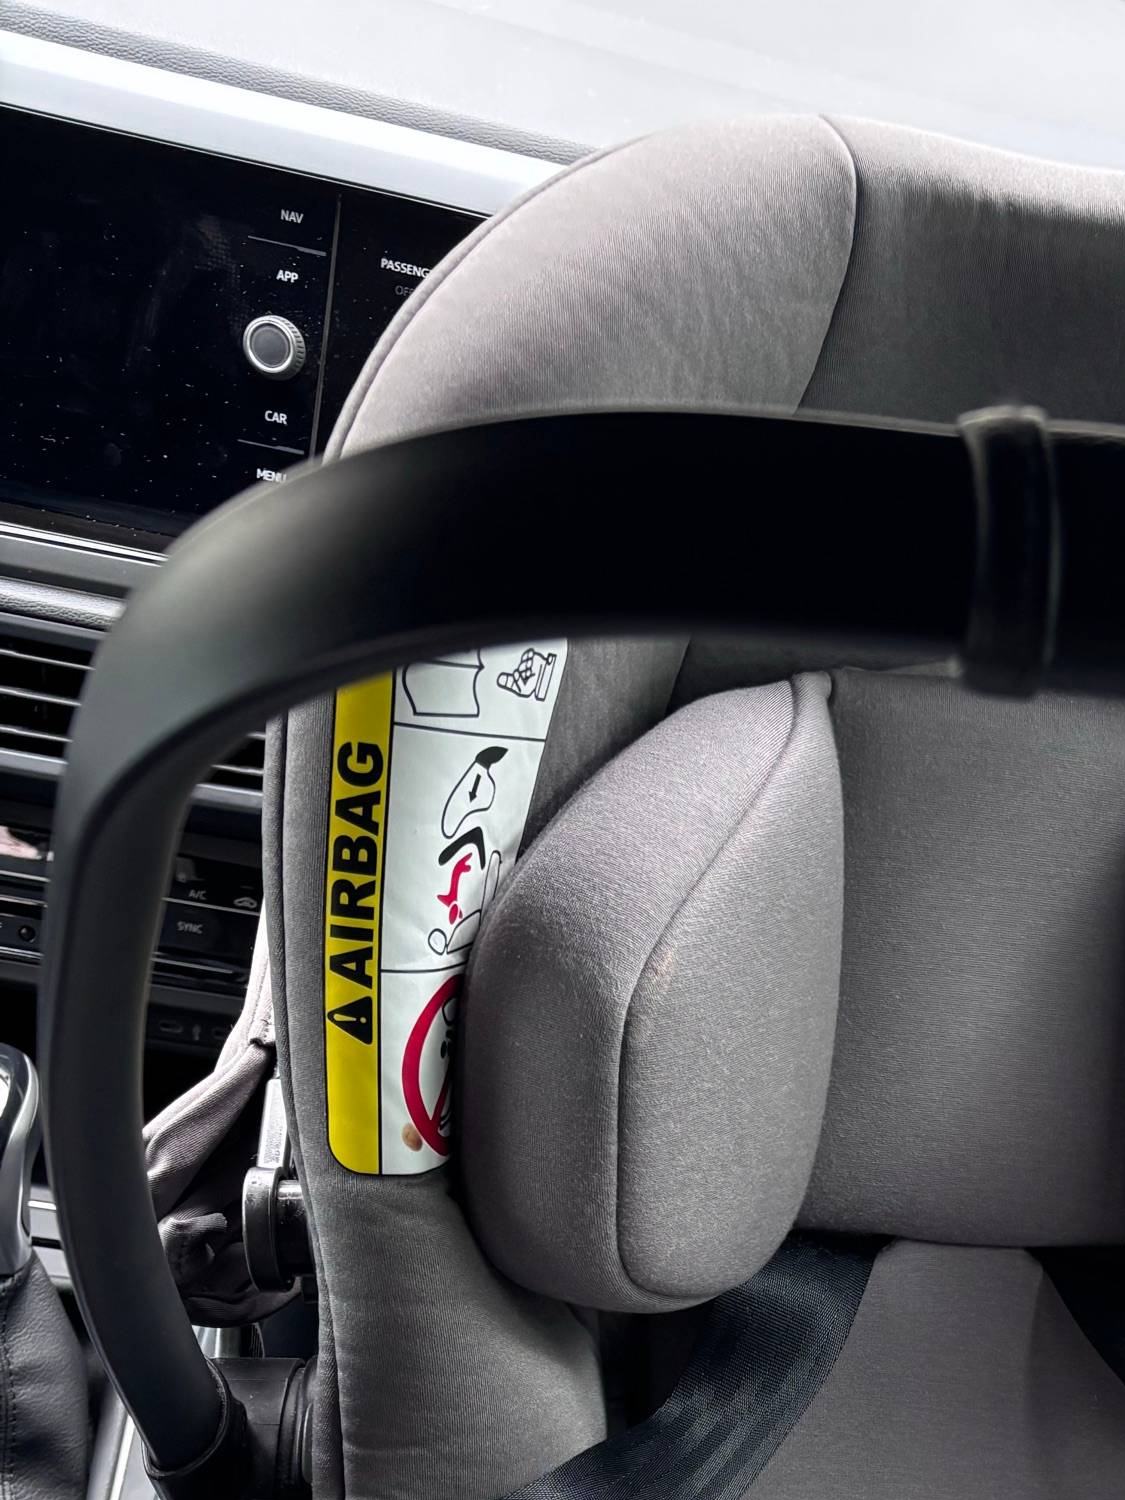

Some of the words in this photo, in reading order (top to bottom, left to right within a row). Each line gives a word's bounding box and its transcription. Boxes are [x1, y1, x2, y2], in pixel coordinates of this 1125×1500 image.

[280, 208, 304, 224] NAV
[276, 269, 299, 283] APP
[264, 410, 288, 425] CAR
[329, 741, 384, 990] AIRBAG
[188, 888, 208, 900] A/C
